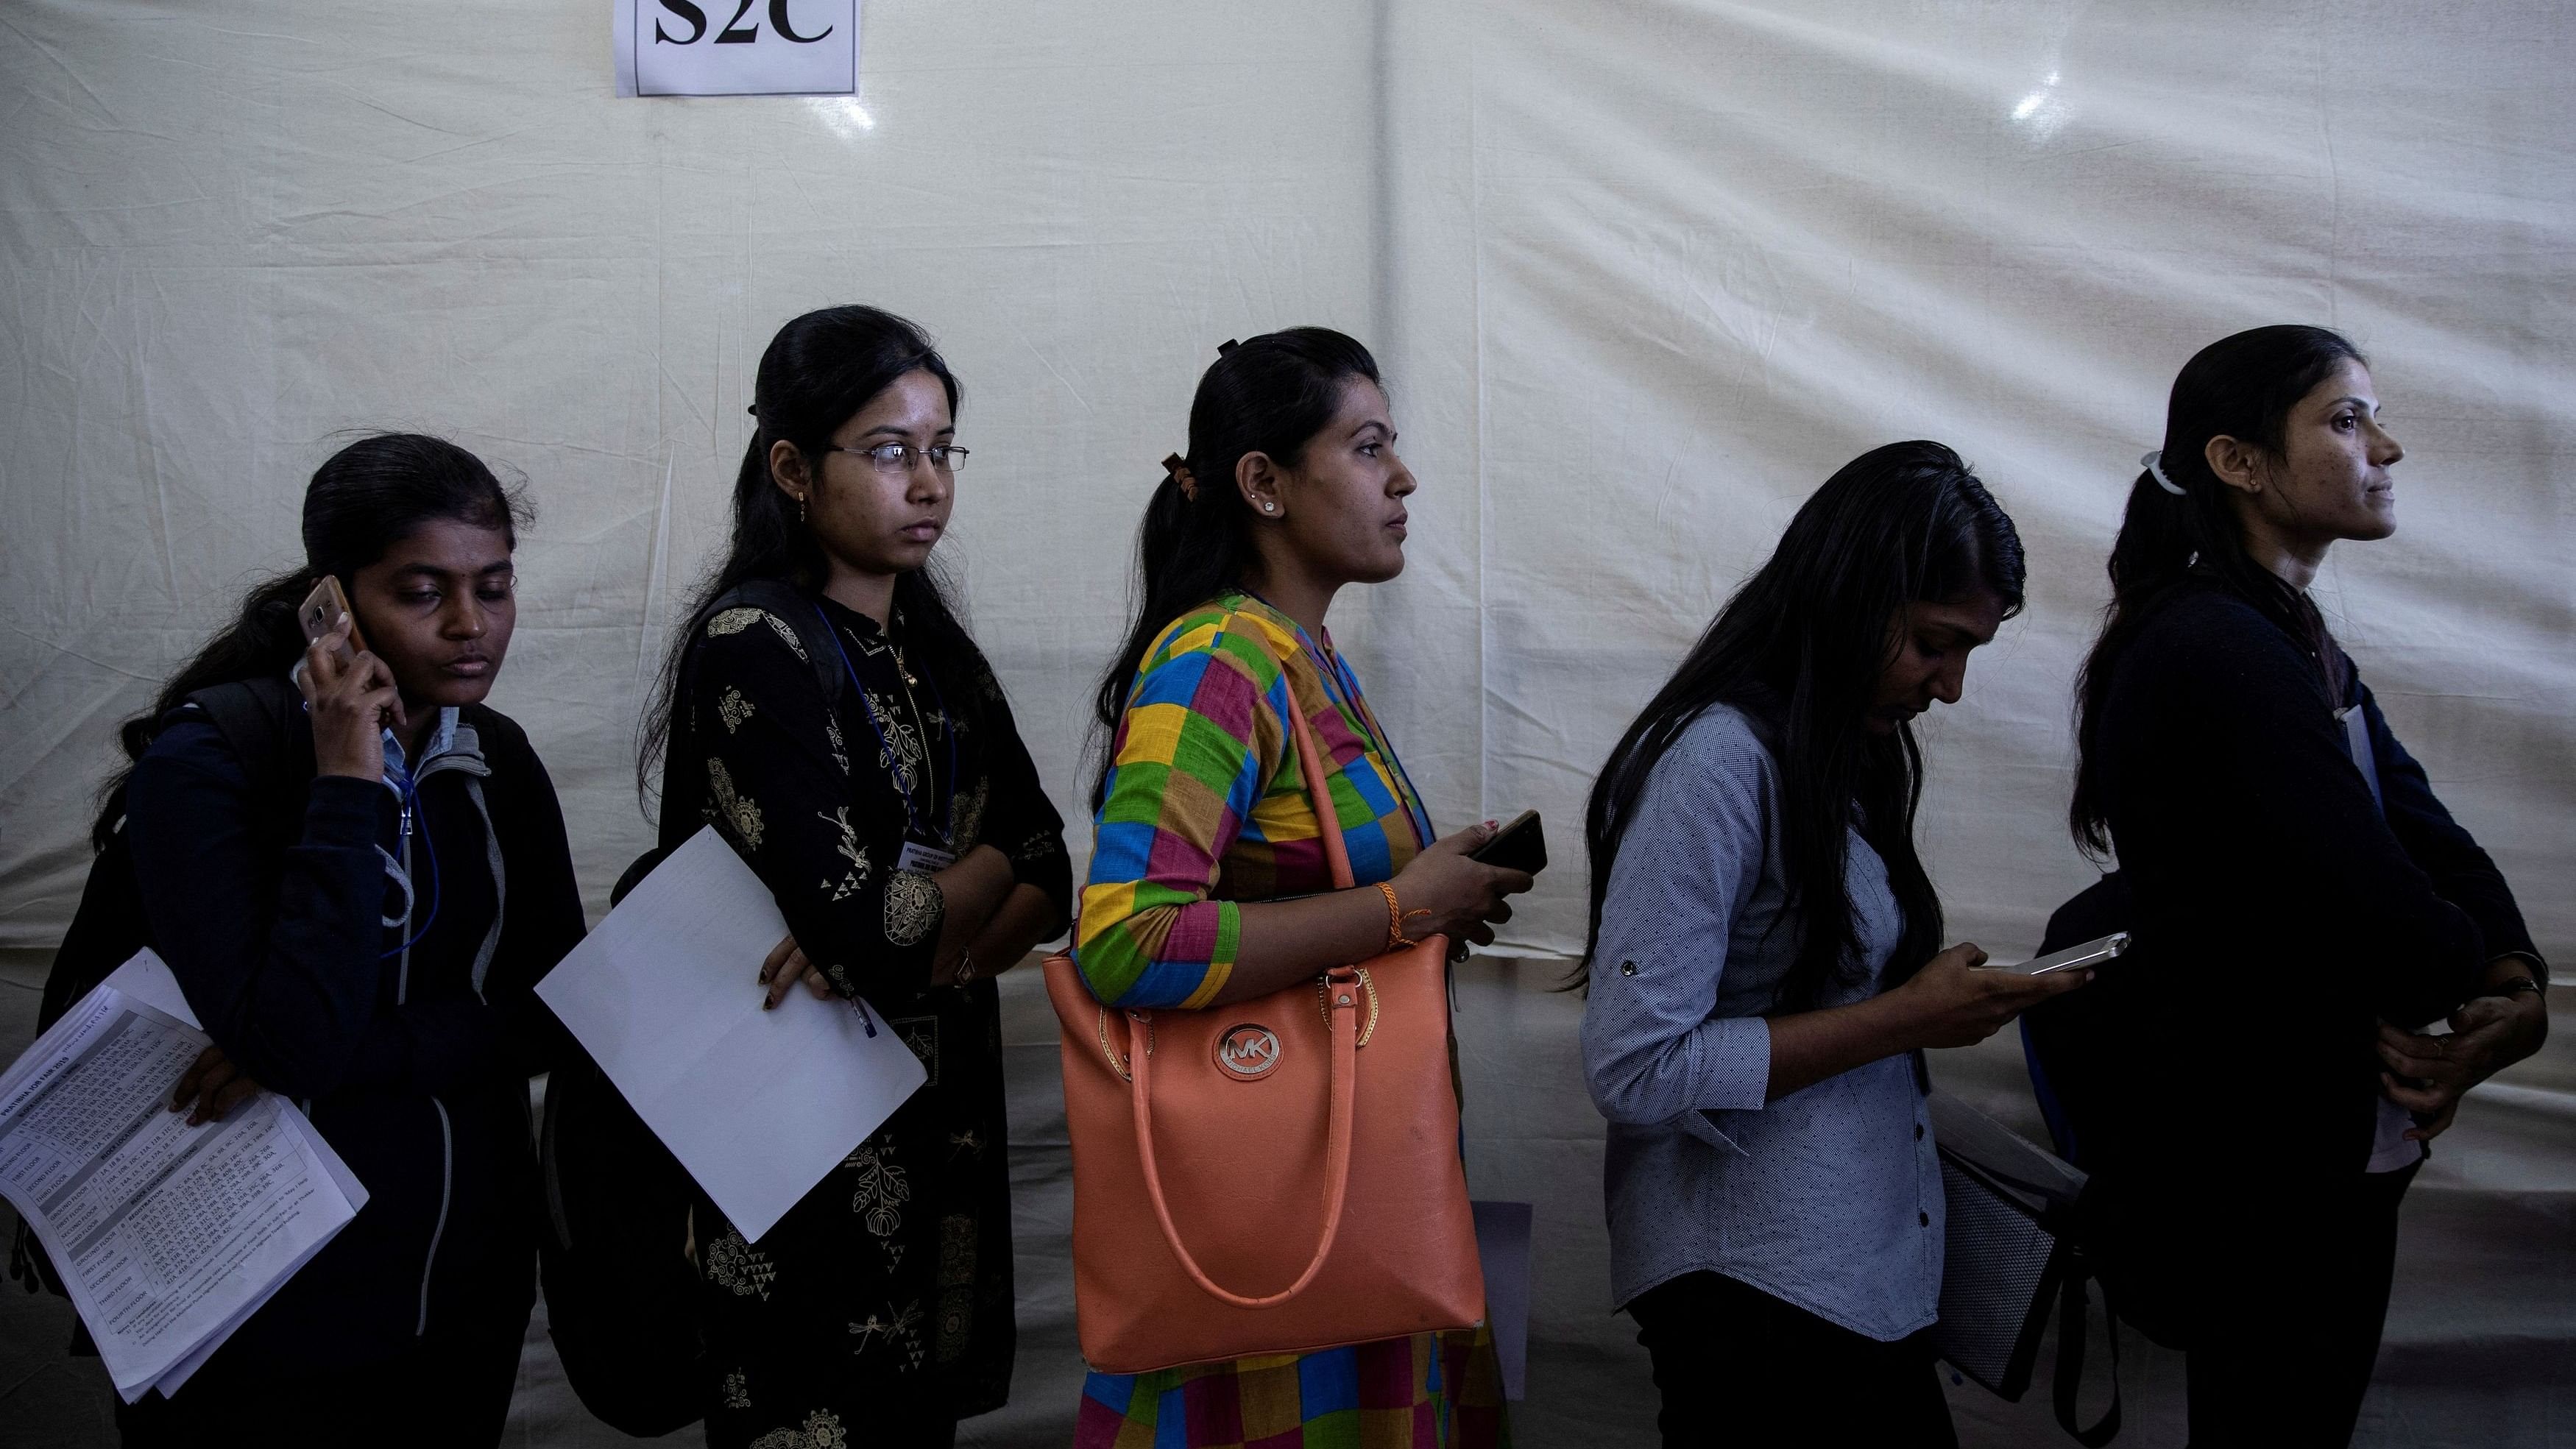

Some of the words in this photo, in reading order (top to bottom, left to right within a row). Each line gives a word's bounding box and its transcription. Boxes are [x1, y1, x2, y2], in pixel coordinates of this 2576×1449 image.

[656, 0, 833, 45] S2C
[1225, 1058, 1259, 1073] MICHAEL
[1259, 1054, 1277, 1070] KORS
[1227, 1035, 1269, 1060] MK
[0, 1090, 32, 1116] PRATIBHA
[28, 1080, 43, 1091] JOB
[40, 1069, 56, 1080] FAIR
[52, 1056, 70, 1069] 2019
[99, 1144, 116, 1160] BLOCK
[115, 1121, 143, 1146] LOCATIONS
[148, 1101, 164, 1116] WING
[15, 1142, 32, 1156] FLOOR
[11, 1169, 26, 1182] FIRST
[23, 1156, 41, 1171] FLOOR
[25, 1173, 46, 1192] SECOND
[43, 1159, 61, 1175] FLOOR
[130, 1188, 147, 1205] BLOCK
[146, 1164, 175, 1191] LOCATIONS
[182, 1144, 198, 1161] WING
[35, 1187, 52, 1202] THIRD
[49, 1173, 68, 1189] FLOOR
[49, 1199, 72, 1221] GROUND
[71, 1185, 88, 1201] FLOOR
[55, 1216, 69, 1230] FIRST
[68, 1202, 85, 1218] FLOOR
[60, 1219, 82, 1239] SECOND
[80, 1204, 98, 1221] FLOOR
[127, 1188, 164, 1222] REGISTRATION
[66, 1232, 82, 1248] THIRD
[81, 1217, 99, 1235] FLOOR
[76, 1244, 100, 1266] GROUND
[99, 1230, 116, 1247] FLOOR
[82, 1264, 96, 1278] FIRST
[96, 1249, 114, 1266] FLOOR
[88, 1269, 111, 1291] SECOND
[110, 1255, 128, 1272] FLOOR
[98, 1289, 116, 1306] THIRD
[114, 1275, 132, 1292] FLOOR
[108, 1304, 130, 1325] FOURTH
[130, 1289, 147, 1307] FLOOR
